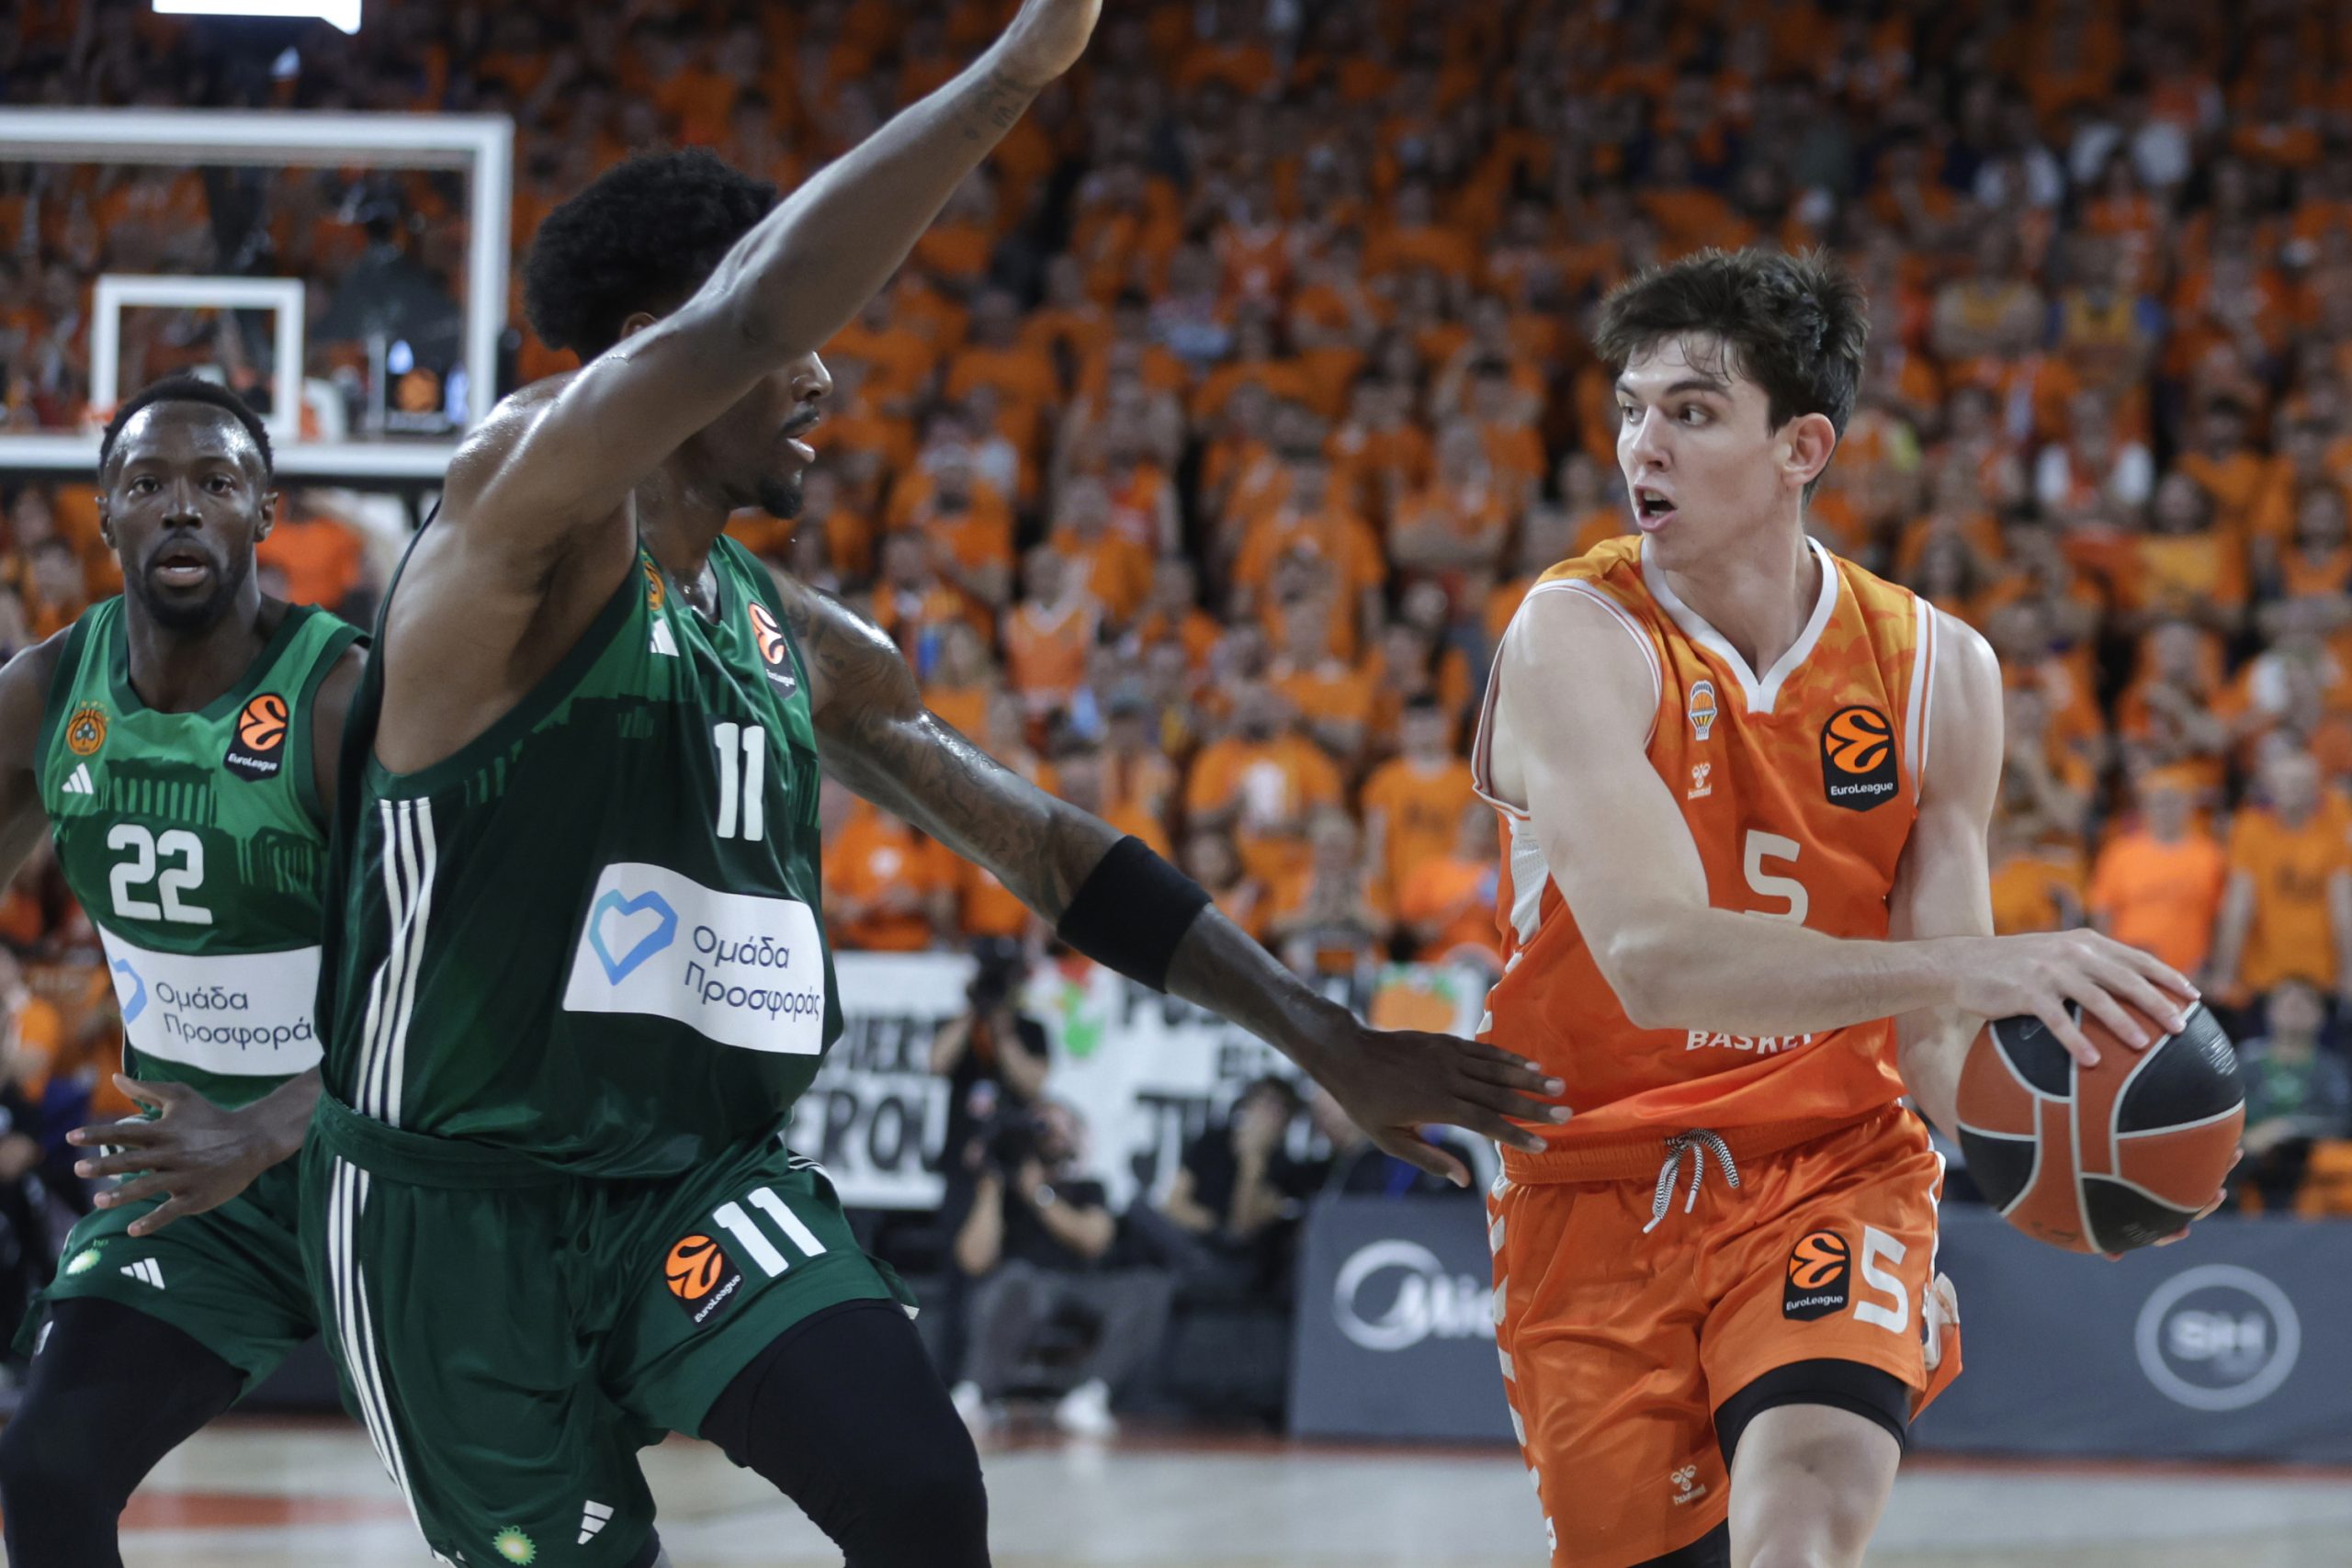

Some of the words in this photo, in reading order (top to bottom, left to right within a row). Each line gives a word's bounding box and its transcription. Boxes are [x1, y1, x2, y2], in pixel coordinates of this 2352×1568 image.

[228, 752, 278, 773] EuroLeague
[714, 722, 765, 841] 11
[1830, 782, 1894, 797] EuroLeague
[107, 823, 214, 925] 22
[1744, 829, 1809, 926] 5
[693, 924, 790, 968] Ομάδα
[155, 981, 249, 1012] Ομάδα
[684, 960, 820, 1023] Προσφοράς
[711, 1186, 828, 1278] 11
[695, 1274, 742, 1324] EuroLeague
[1785, 1294, 1844, 1312] EuroLeague
[1852, 1224, 1909, 1335] 5
